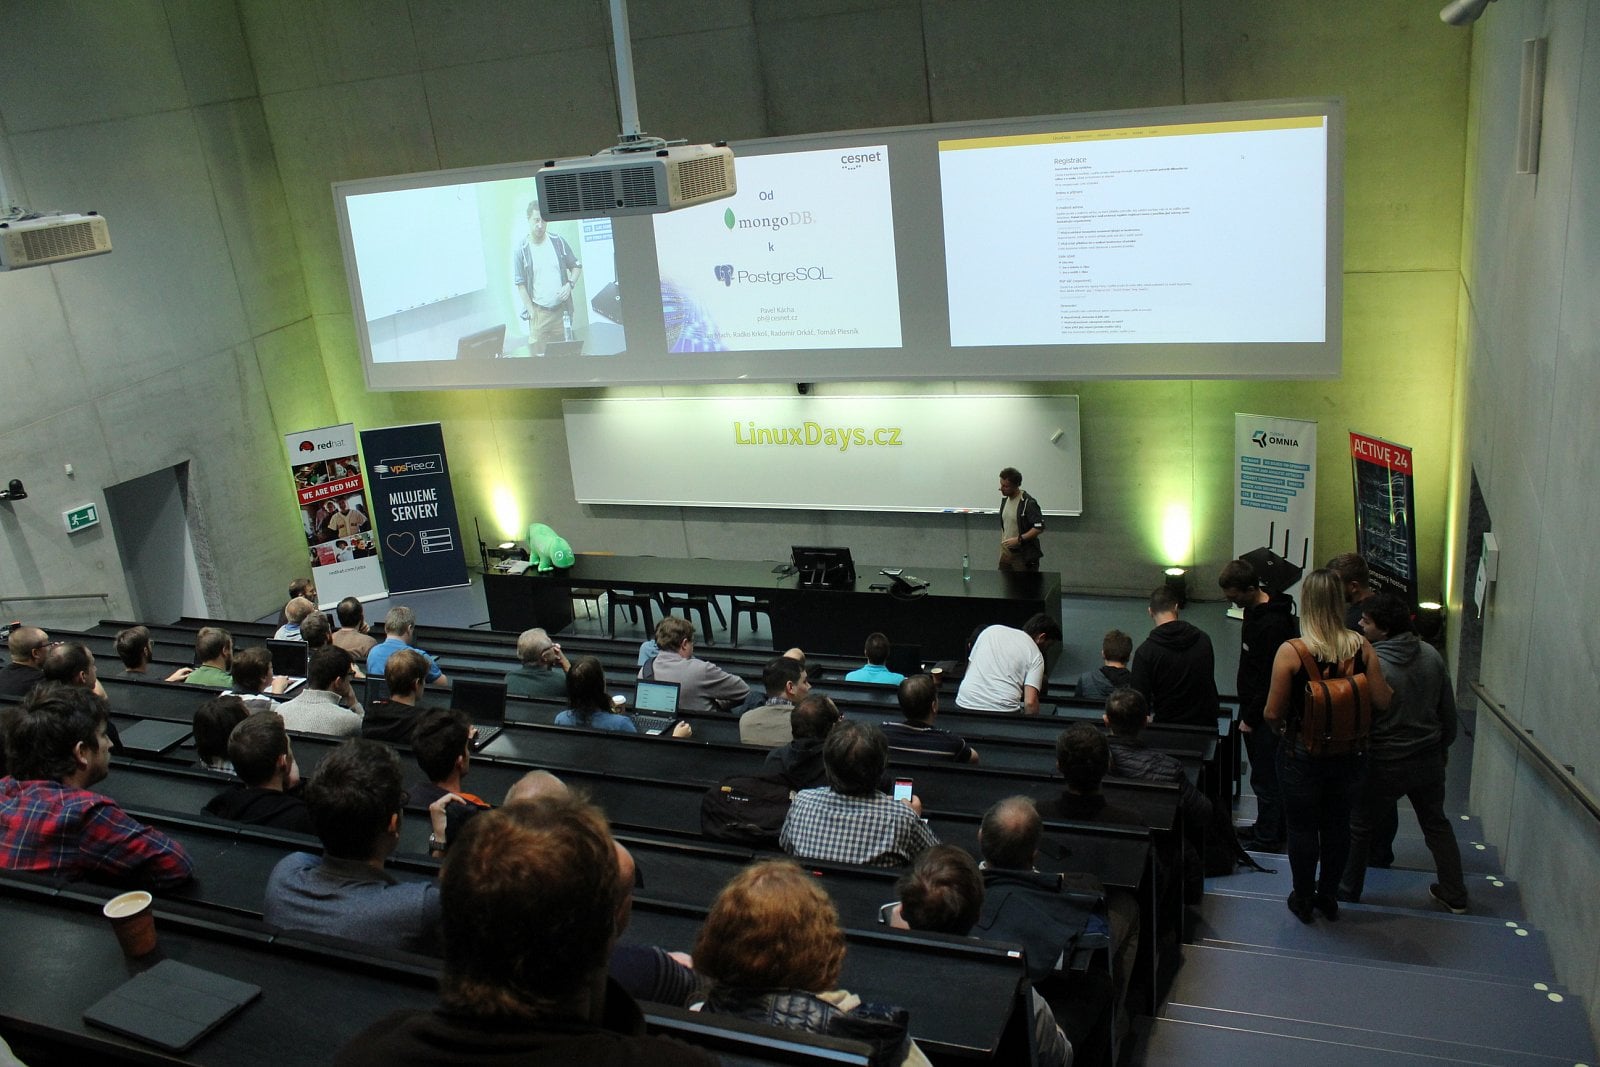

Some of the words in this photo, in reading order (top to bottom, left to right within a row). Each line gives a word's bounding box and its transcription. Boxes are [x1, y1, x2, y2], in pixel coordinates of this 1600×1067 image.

[840, 151, 882, 165] cesnet
[1053, 156, 1087, 166] Registrace
[758, 190, 774, 201] Od
[768, 241, 775, 252] k
[737, 266, 833, 285] PostgreSQL
[734, 421, 903, 451] LinuxDays.cz
[1269, 437, 1299, 447] OMNIA
[1354, 438, 1391, 463] ACTIVE
[1394, 451, 1408, 468] 24
[302, 492, 314, 500] WE
[315, 487, 328, 498] ARE
[330, 483, 344, 494] RED
[345, 479, 359, 489] HAT
[389, 488, 438, 506] MILUJEME
[391, 503, 439, 522] SERVERY
